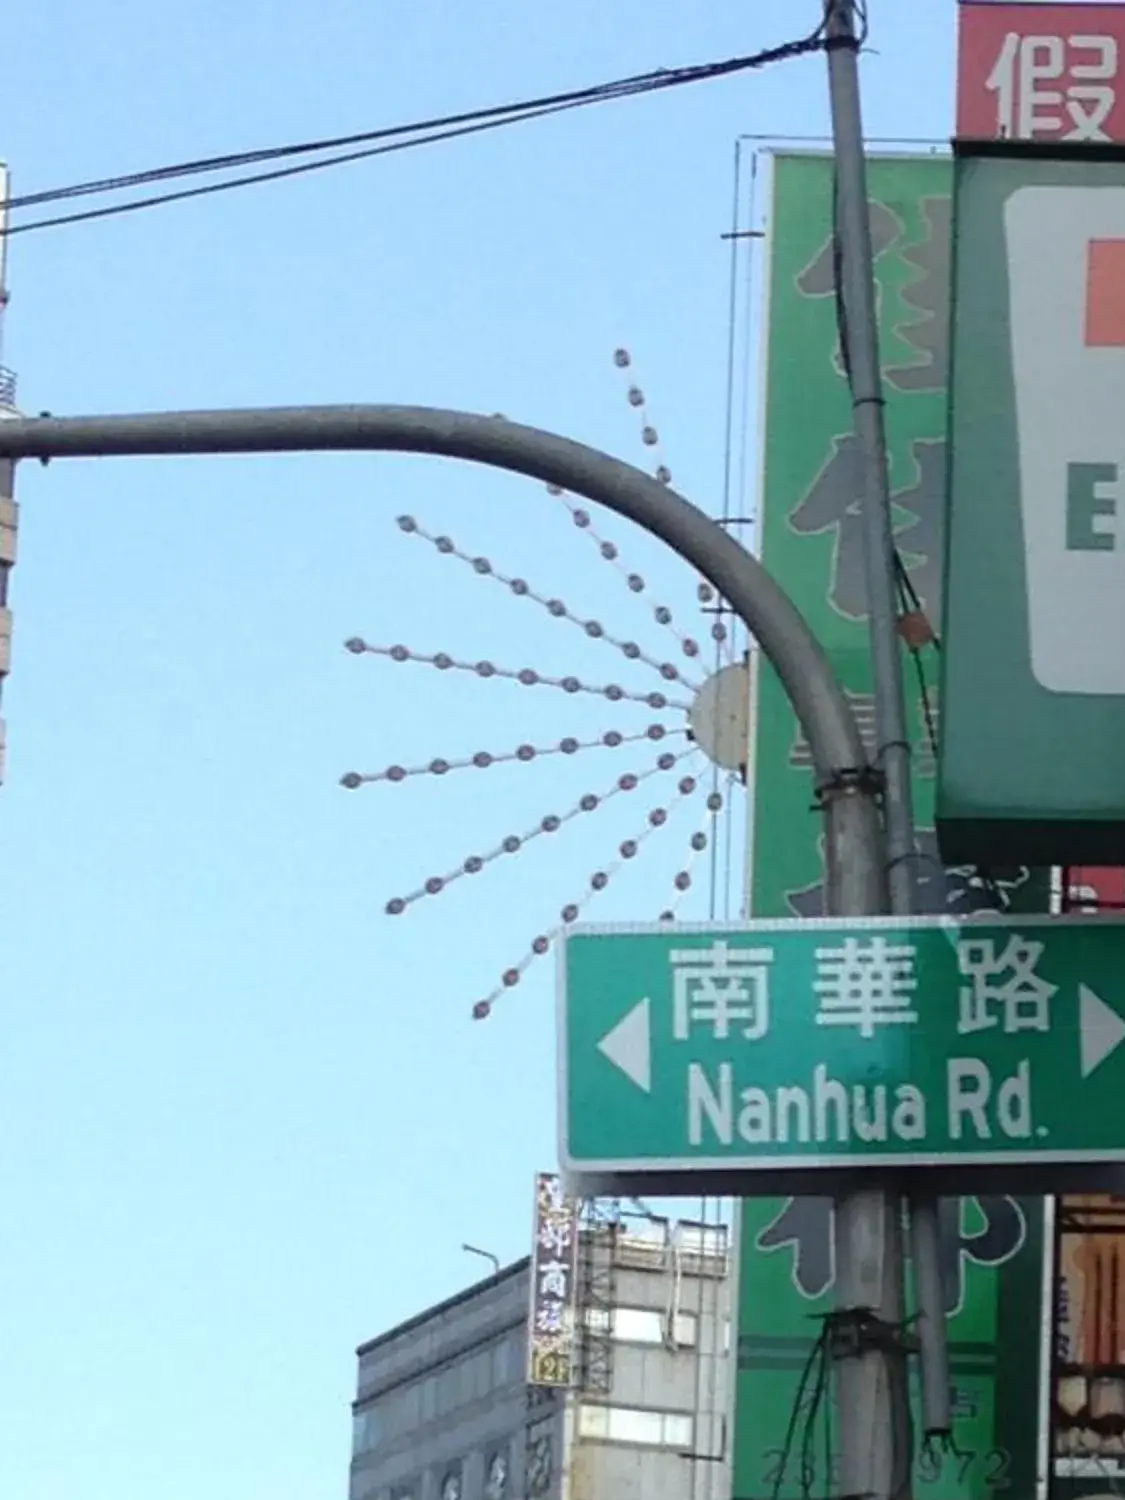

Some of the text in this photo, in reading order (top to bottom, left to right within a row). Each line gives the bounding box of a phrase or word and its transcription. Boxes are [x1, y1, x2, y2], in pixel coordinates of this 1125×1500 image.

[668, 935, 1060, 1041] 南華路
[686, 1056, 1051, 1146] Nanhua Rd.
